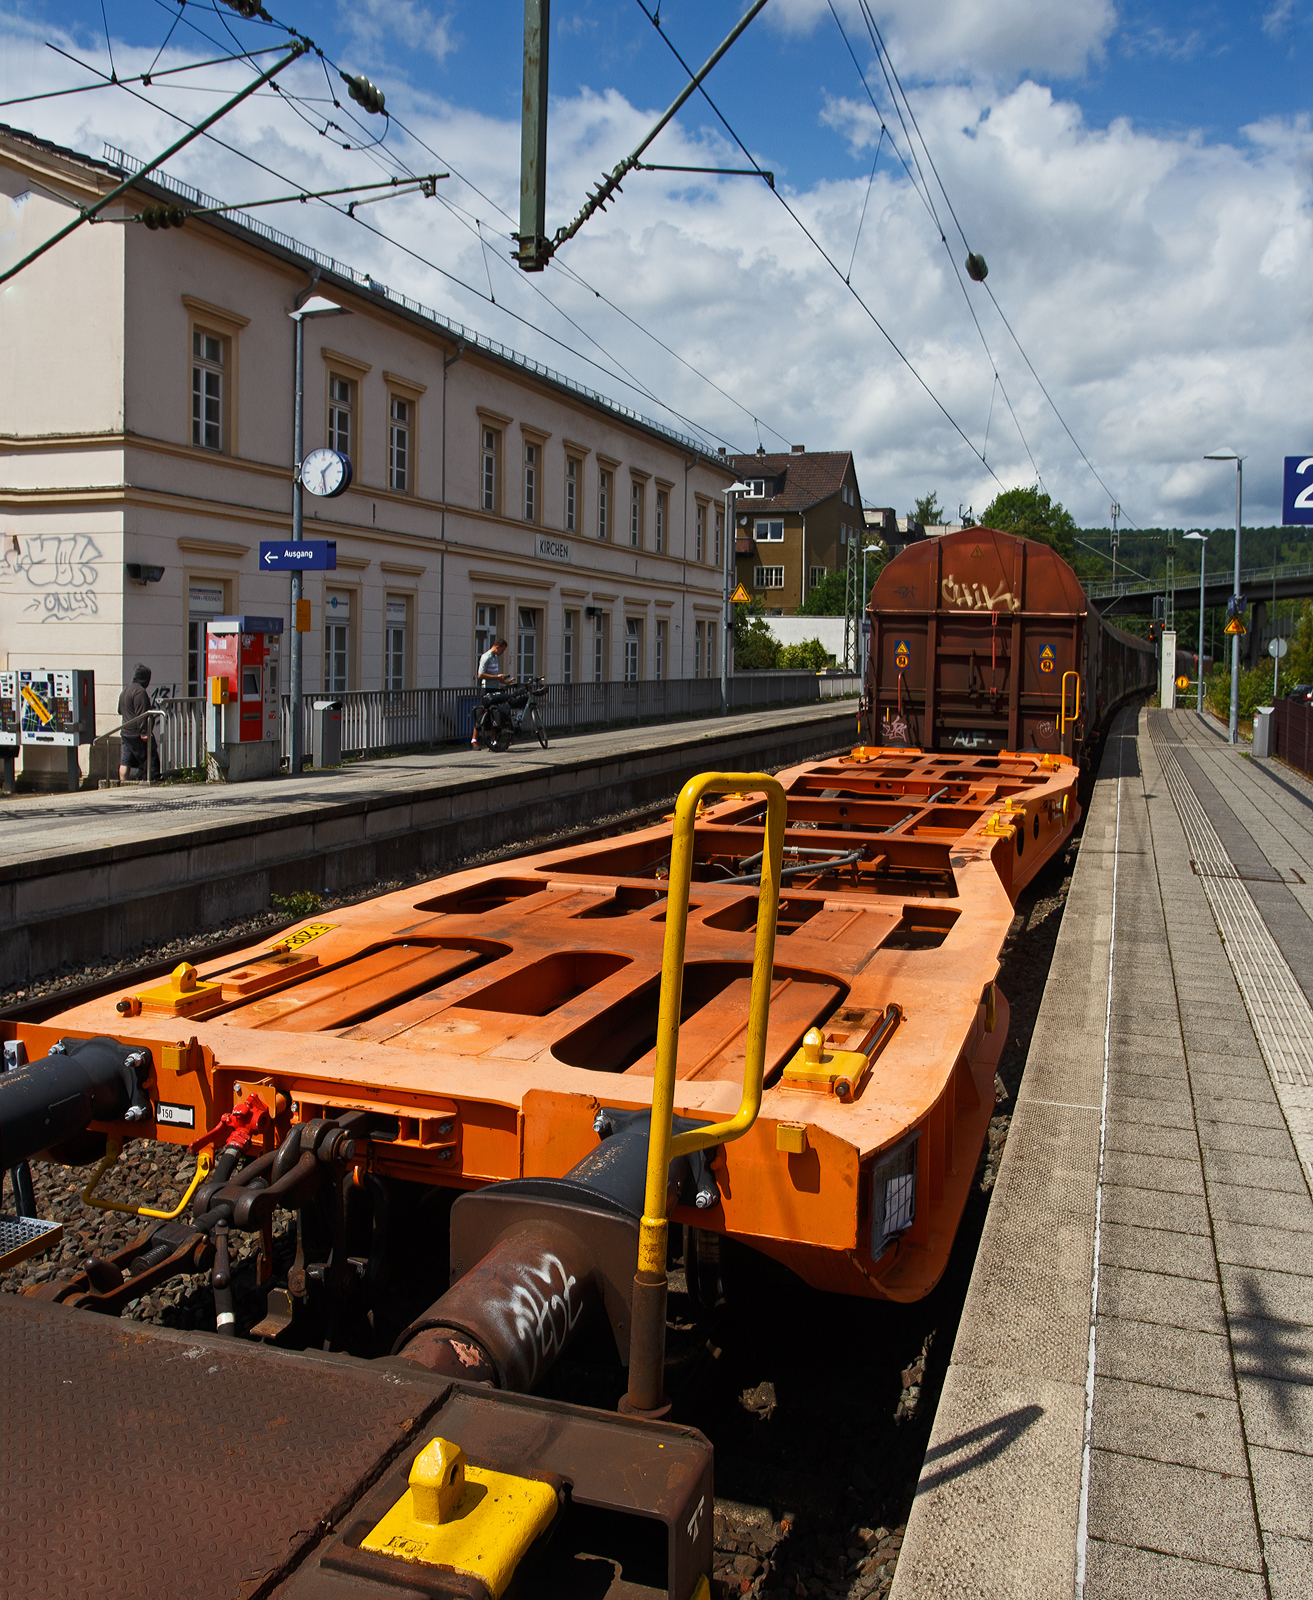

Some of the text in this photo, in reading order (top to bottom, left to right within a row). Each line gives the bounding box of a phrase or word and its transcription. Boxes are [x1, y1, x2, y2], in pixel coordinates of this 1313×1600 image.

[1293, 457, 1313, 509] 2
[284, 549, 313, 559] Ausgang
[539, 539, 569, 558] KIRCHEN
[161, 1108, 173, 1119] 150
